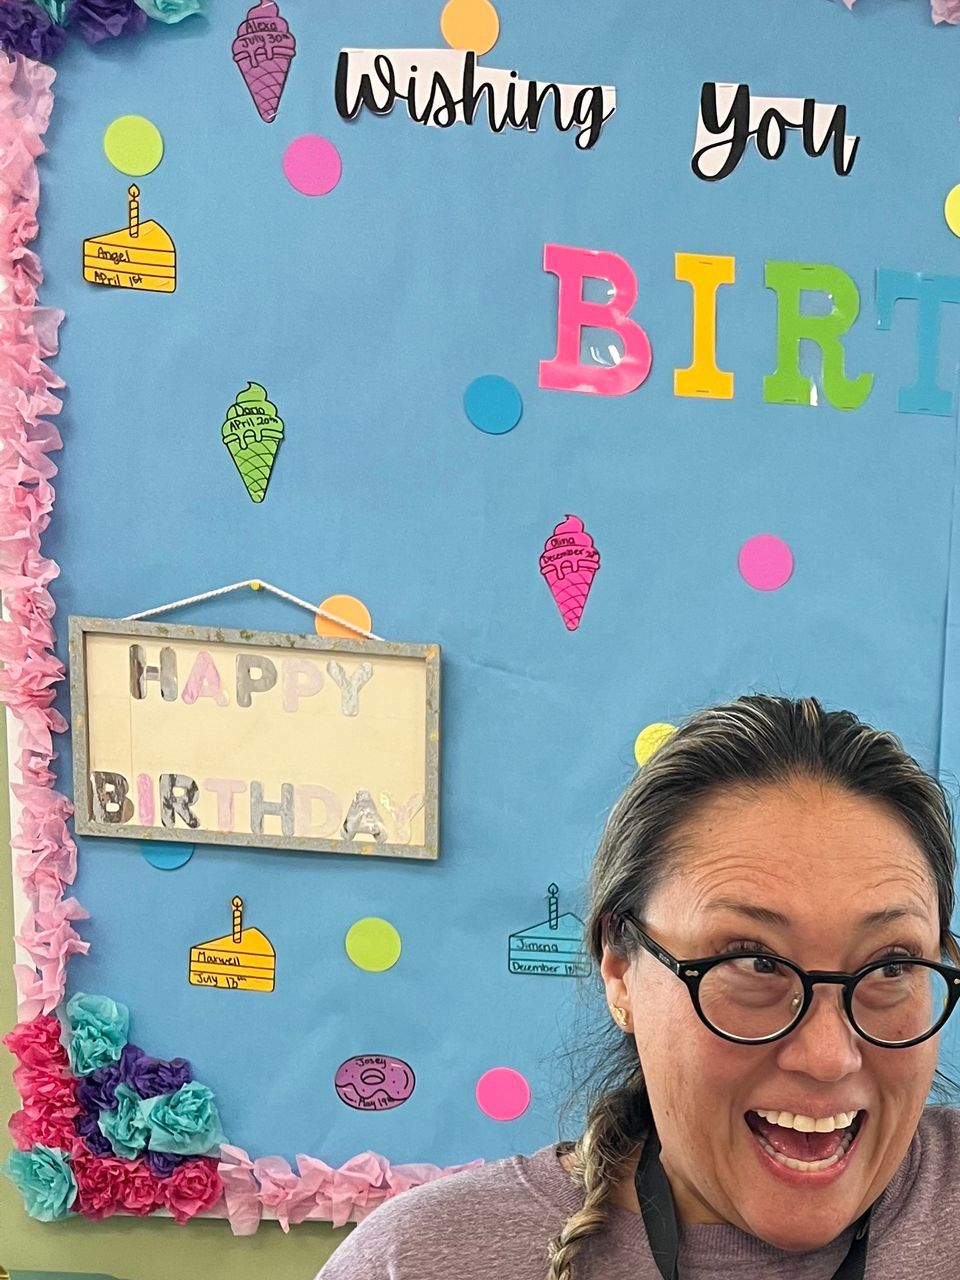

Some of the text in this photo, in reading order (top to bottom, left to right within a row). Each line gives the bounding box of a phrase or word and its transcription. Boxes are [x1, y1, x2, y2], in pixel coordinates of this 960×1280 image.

[245, 21, 278, 33] Alexa
[239, 35, 265, 49] July
[335, 50, 615, 149] Wishing
[691, 82, 860, 181] You
[98, 247, 131, 265] Angel
[128, 643, 374, 717] HAPPY
[89, 770, 426, 845] BIRTHDAY
[512, 961, 558, 973] December
[194, 973, 218, 987] July
[355, 1058, 387, 1069] Josey
